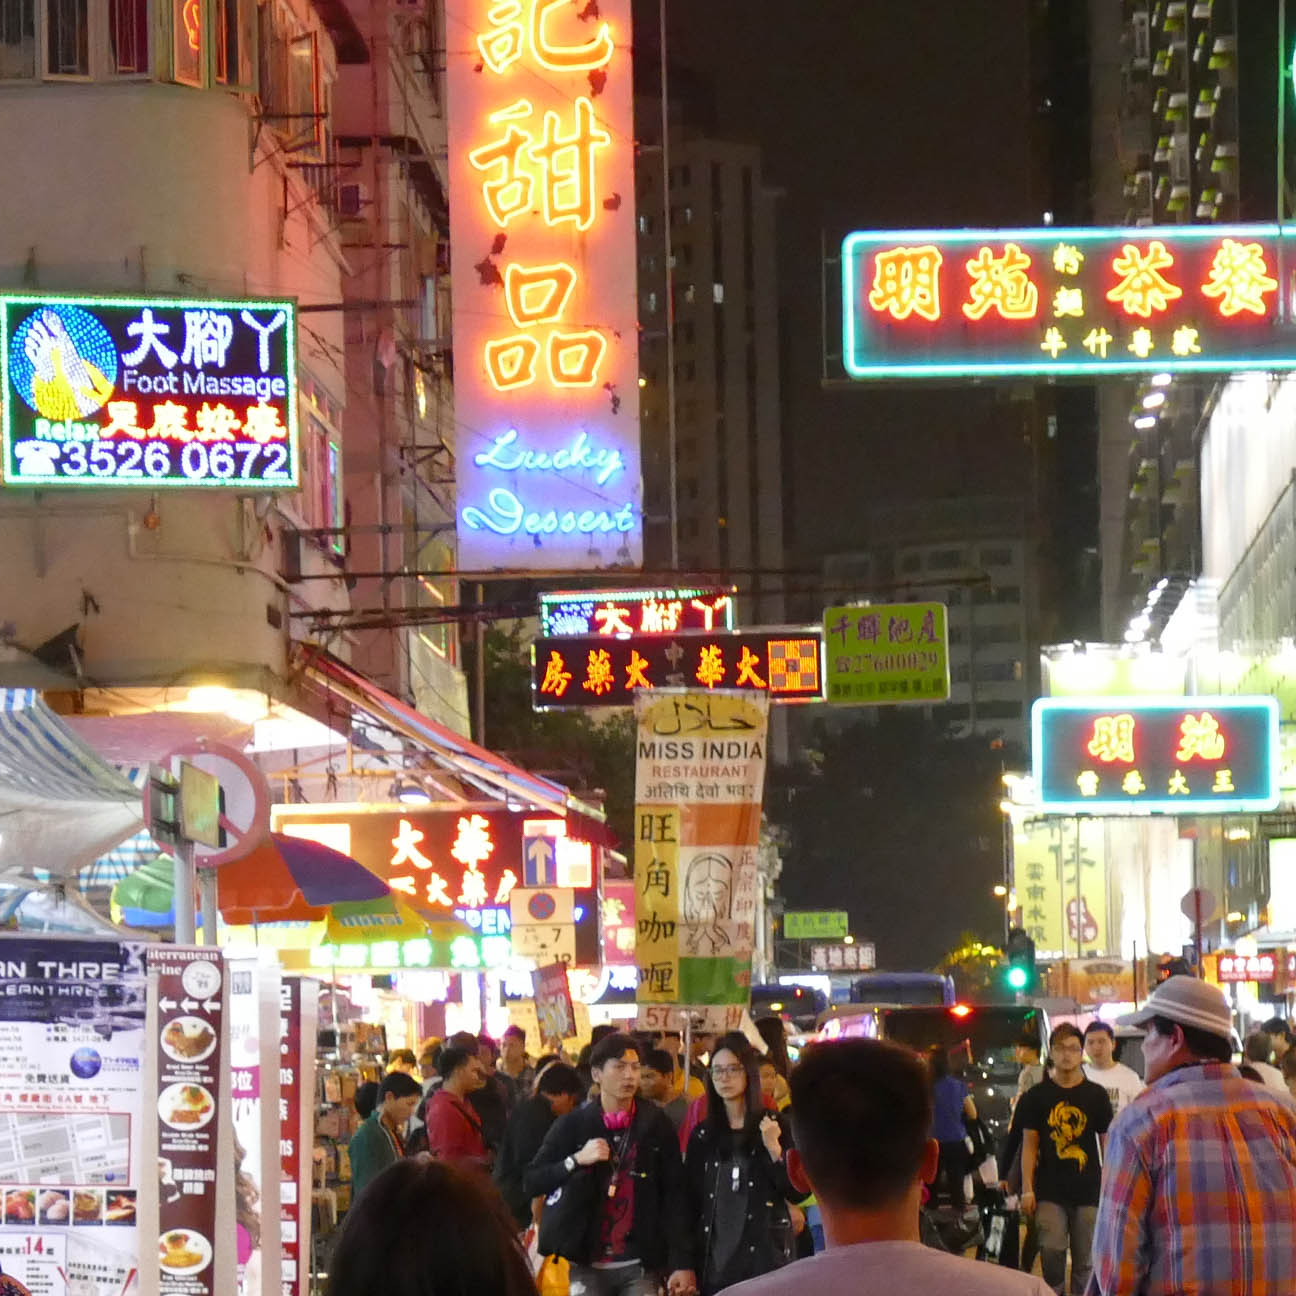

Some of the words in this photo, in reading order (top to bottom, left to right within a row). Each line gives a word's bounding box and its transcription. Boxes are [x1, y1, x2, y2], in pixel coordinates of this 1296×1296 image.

[121, 306, 287, 373] 大腳丫
[122, 370, 179, 394] Foot
[183, 373, 287, 402] Massage
[35, 418, 101, 441] Relax
[61, 440, 171, 477] 3526
[181, 442, 289, 479] 0672
[475, 428, 623, 485] Lucky
[462, 487, 634, 536] Dessert
[639, 741, 694, 760] MISS
[703, 741, 763, 760] INDIA
[652, 764, 749, 778] RESTAURANT
